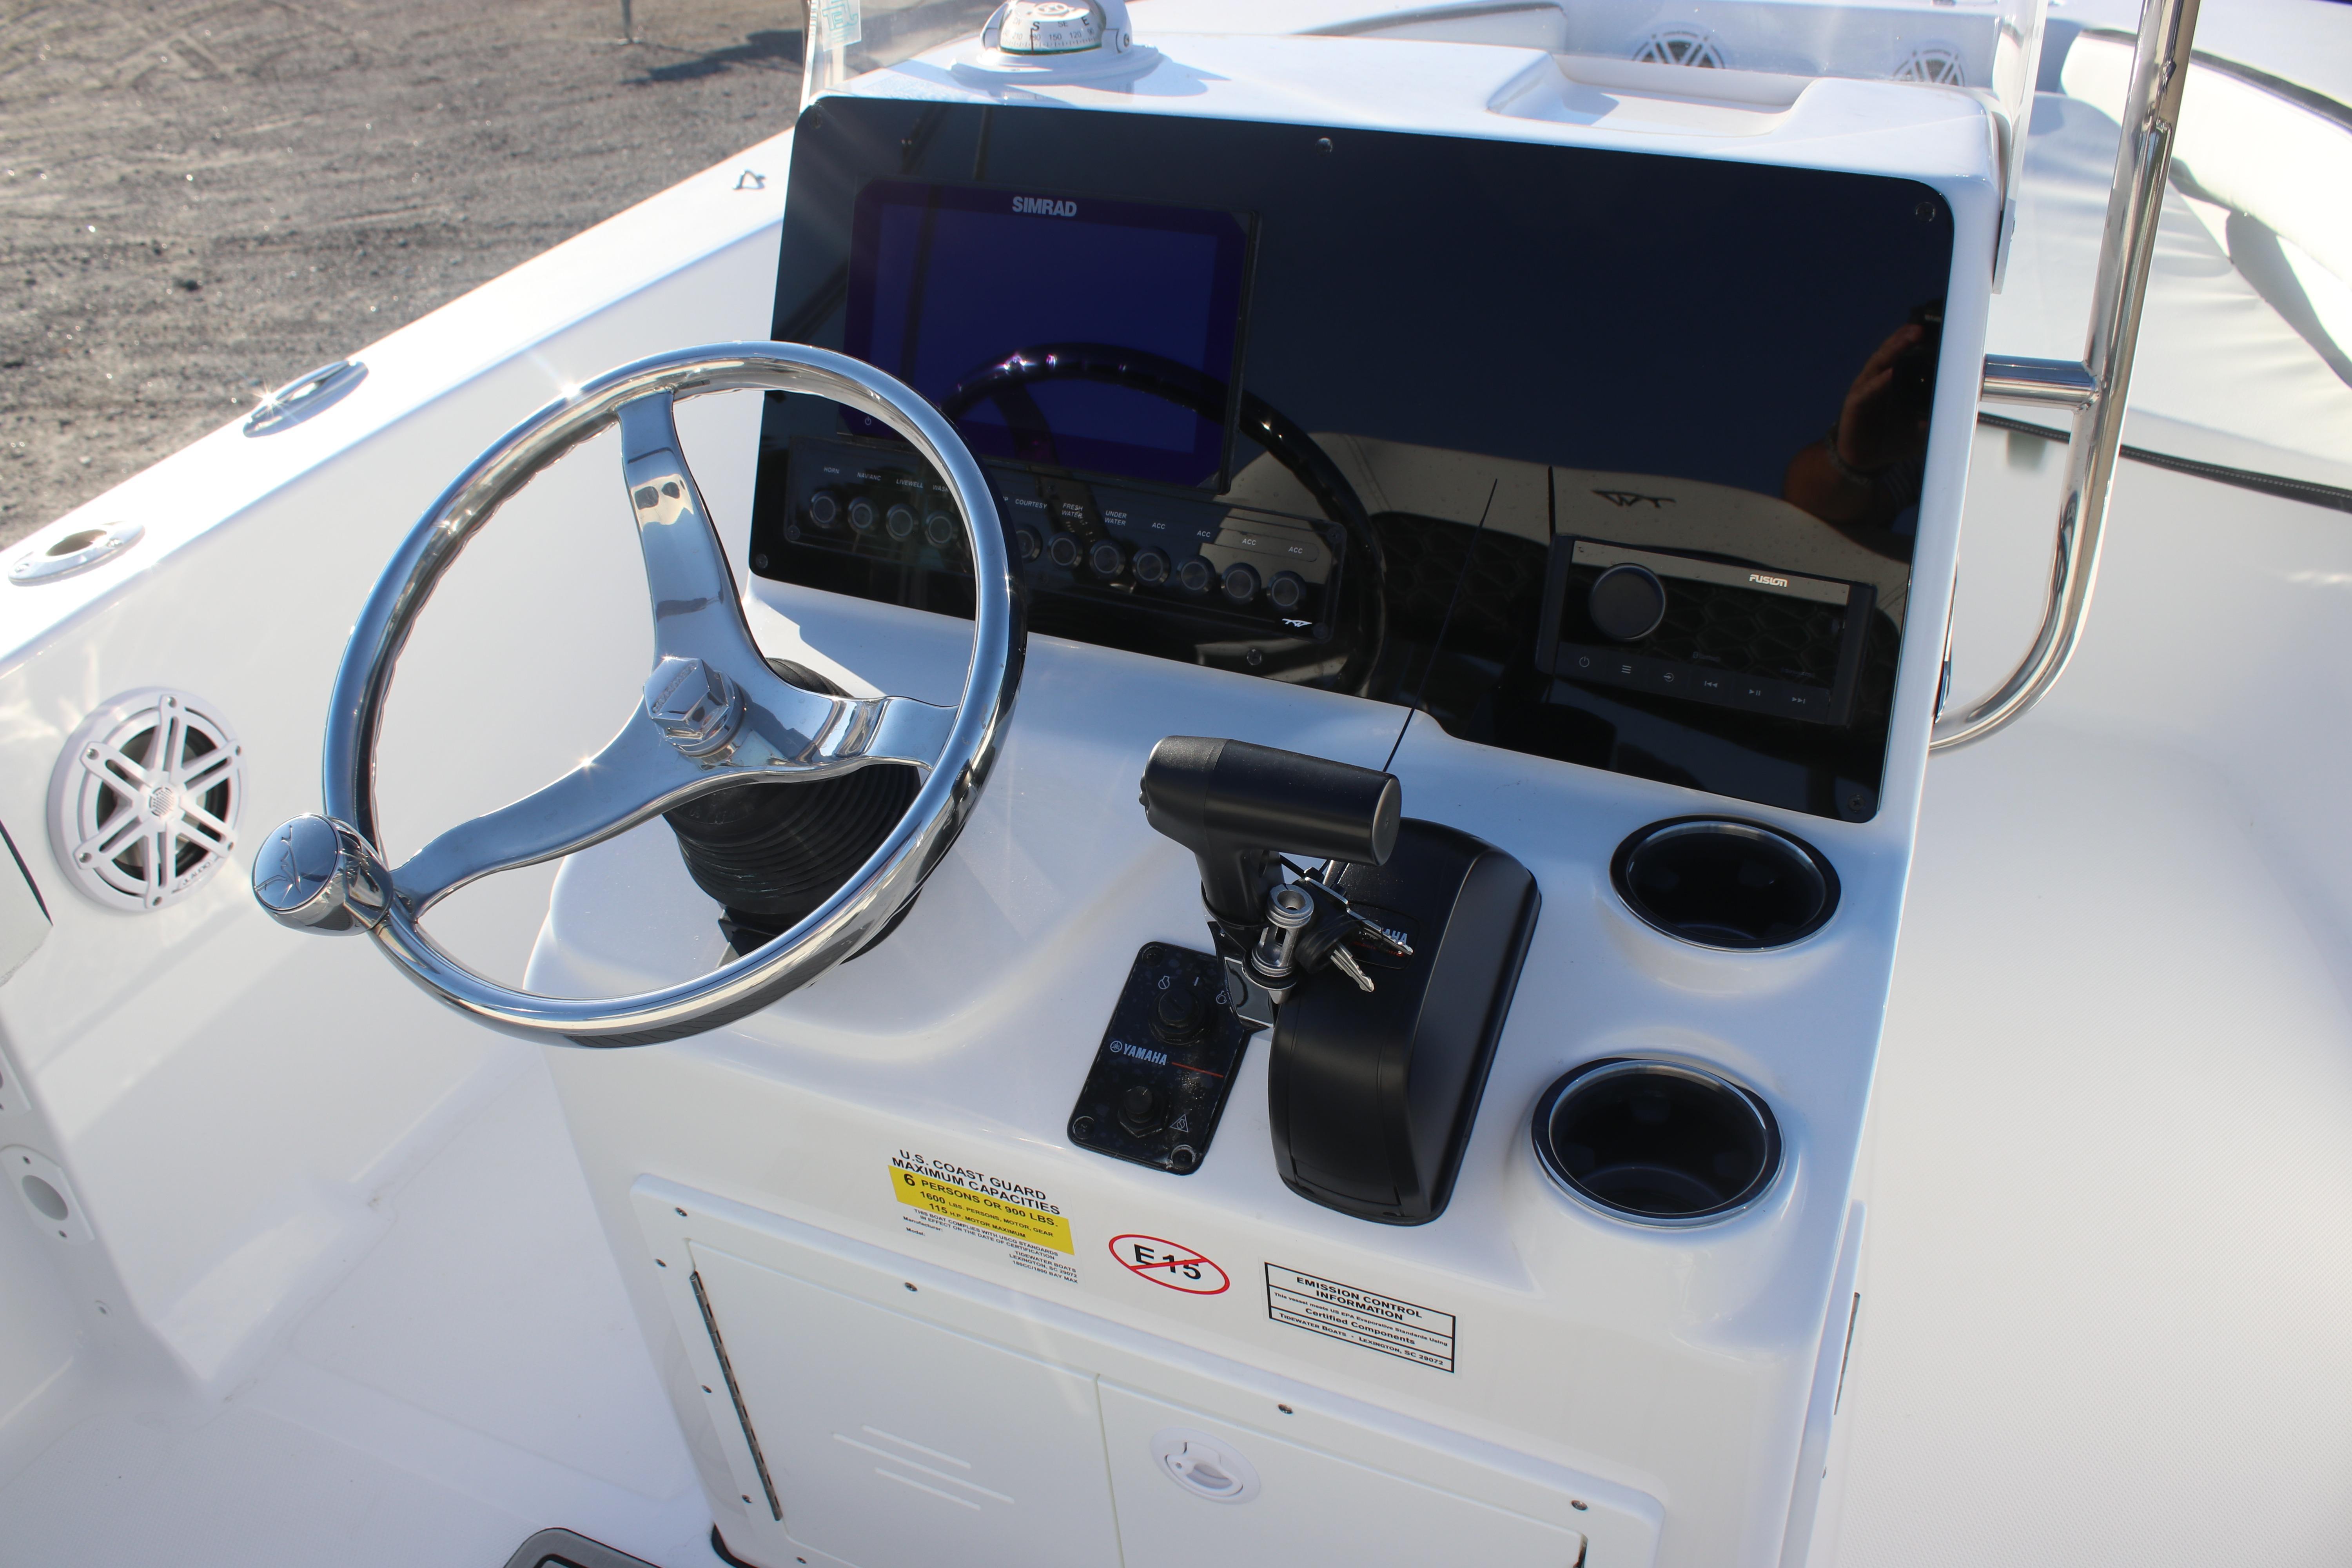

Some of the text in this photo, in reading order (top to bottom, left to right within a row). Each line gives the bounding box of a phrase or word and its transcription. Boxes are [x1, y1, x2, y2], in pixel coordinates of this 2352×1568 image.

[1031, 22, 1040, 31] S
[1081, 17, 1089, 26] E
[1012, 196, 1077, 217] SIMRAD
[896, 479, 923, 488] LIVEWELL
[1015, 499, 1047, 509] COURTESY
[1062, 510, 1083, 518] WATER
[1063, 503, 1083, 511] FRESH
[1105, 510, 1127, 519] UNDER
[1105, 517, 1126, 526] WATER
[1749, 574, 1788, 587] FUSION
[1123, 1043, 1167, 1065] YAMAHA
[900, 1149, 1046, 1200] U.S. COAST GUARD
[892, 1157, 1060, 1215] MAXIMUM CAPACITIES
[904, 1173, 1058, 1227] 6 PERSONS OR 900 LBS.
[903, 1216, 943, 1232] Manufacturer:
[920, 1191, 946, 1204] 1600
[949, 1202, 964, 1210] LBS.
[1003, 1218, 1031, 1230] MOTOR,
[1033, 1227, 1053, 1237] GEAR
[929, 1203, 947, 1214] 115
[965, 1216, 991, 1227] MOTOR
[992, 1225, 1026, 1238] MAXIMUM
[906, 1227, 926, 1236] Model:
[928, 1218, 951, 1228] EFFECT
[1006, 1241, 1055, 1260] CERTIFICATION
[929, 1214, 946, 1222] BOAT
[948, 1220, 980, 1232] COMPLIES
[1000, 1235, 1017, 1243] USCG
[1019, 1241, 1058, 1256] STANDARDS
[1009, 1254, 1047, 1269] LEXINGTON,
[1060, 1269, 1077, 1278] 29072
[1015, 1250, 1076, 1272] TIDEWATER BOATS
[1064, 1275, 1078, 1283] MAX
[1297, 1277, 1422, 1318] EMISSION CONTROL
[1316, 1290, 1403, 1320] INFORMATION
[1289, 1295, 1308, 1305] vessel
[1310, 1303, 1328, 1311] meets
[1356, 1316, 1393, 1330] Evaporative
[1395, 1327, 1428, 1340] Standards
[1430, 1338, 1448, 1347] Using
[1305, 1308, 1415, 1345] Certified Components
[1279, 1313, 1319, 1328] TIDEWATER
[1322, 1325, 1347, 1336] BOATS
[1419, 1355, 1443, 1366] 29072
